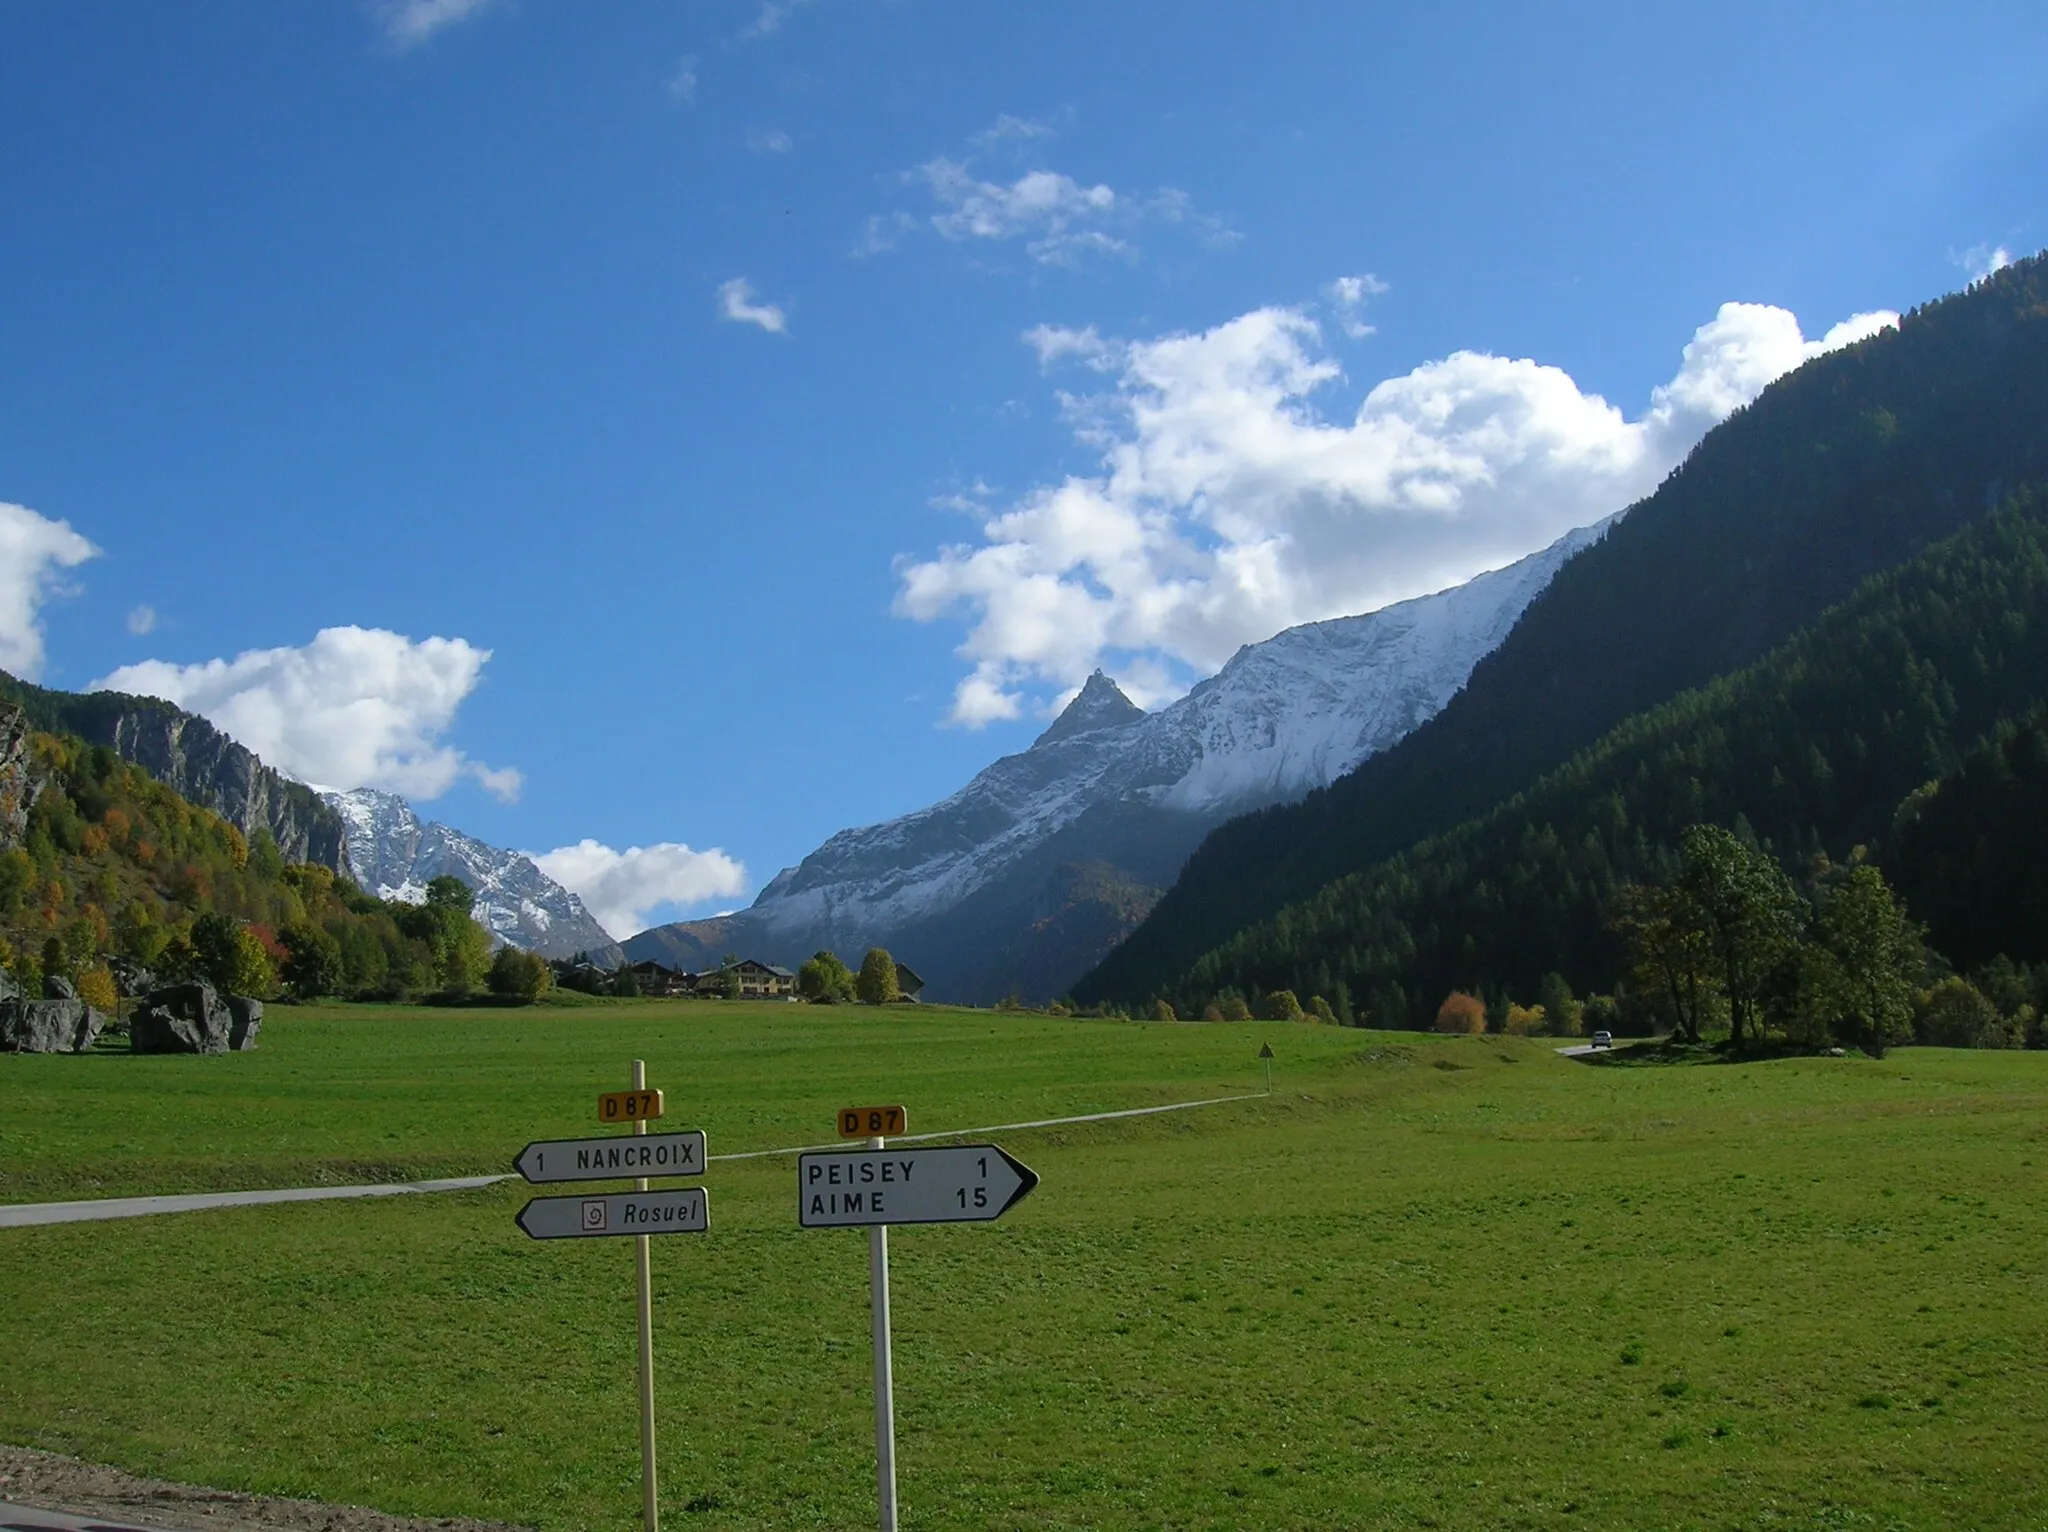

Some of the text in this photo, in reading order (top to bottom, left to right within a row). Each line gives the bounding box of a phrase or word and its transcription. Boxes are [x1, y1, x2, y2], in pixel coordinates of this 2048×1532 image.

[606, 1095, 651, 1117] D 87
[845, 1110, 898, 1133] D 87
[536, 1144, 694, 1172] 1 NANCROIX
[808, 1157, 987, 1185] PEISEY 1
[624, 1200, 697, 1224] Rosuel
[810, 1187, 987, 1215] AIME 15
